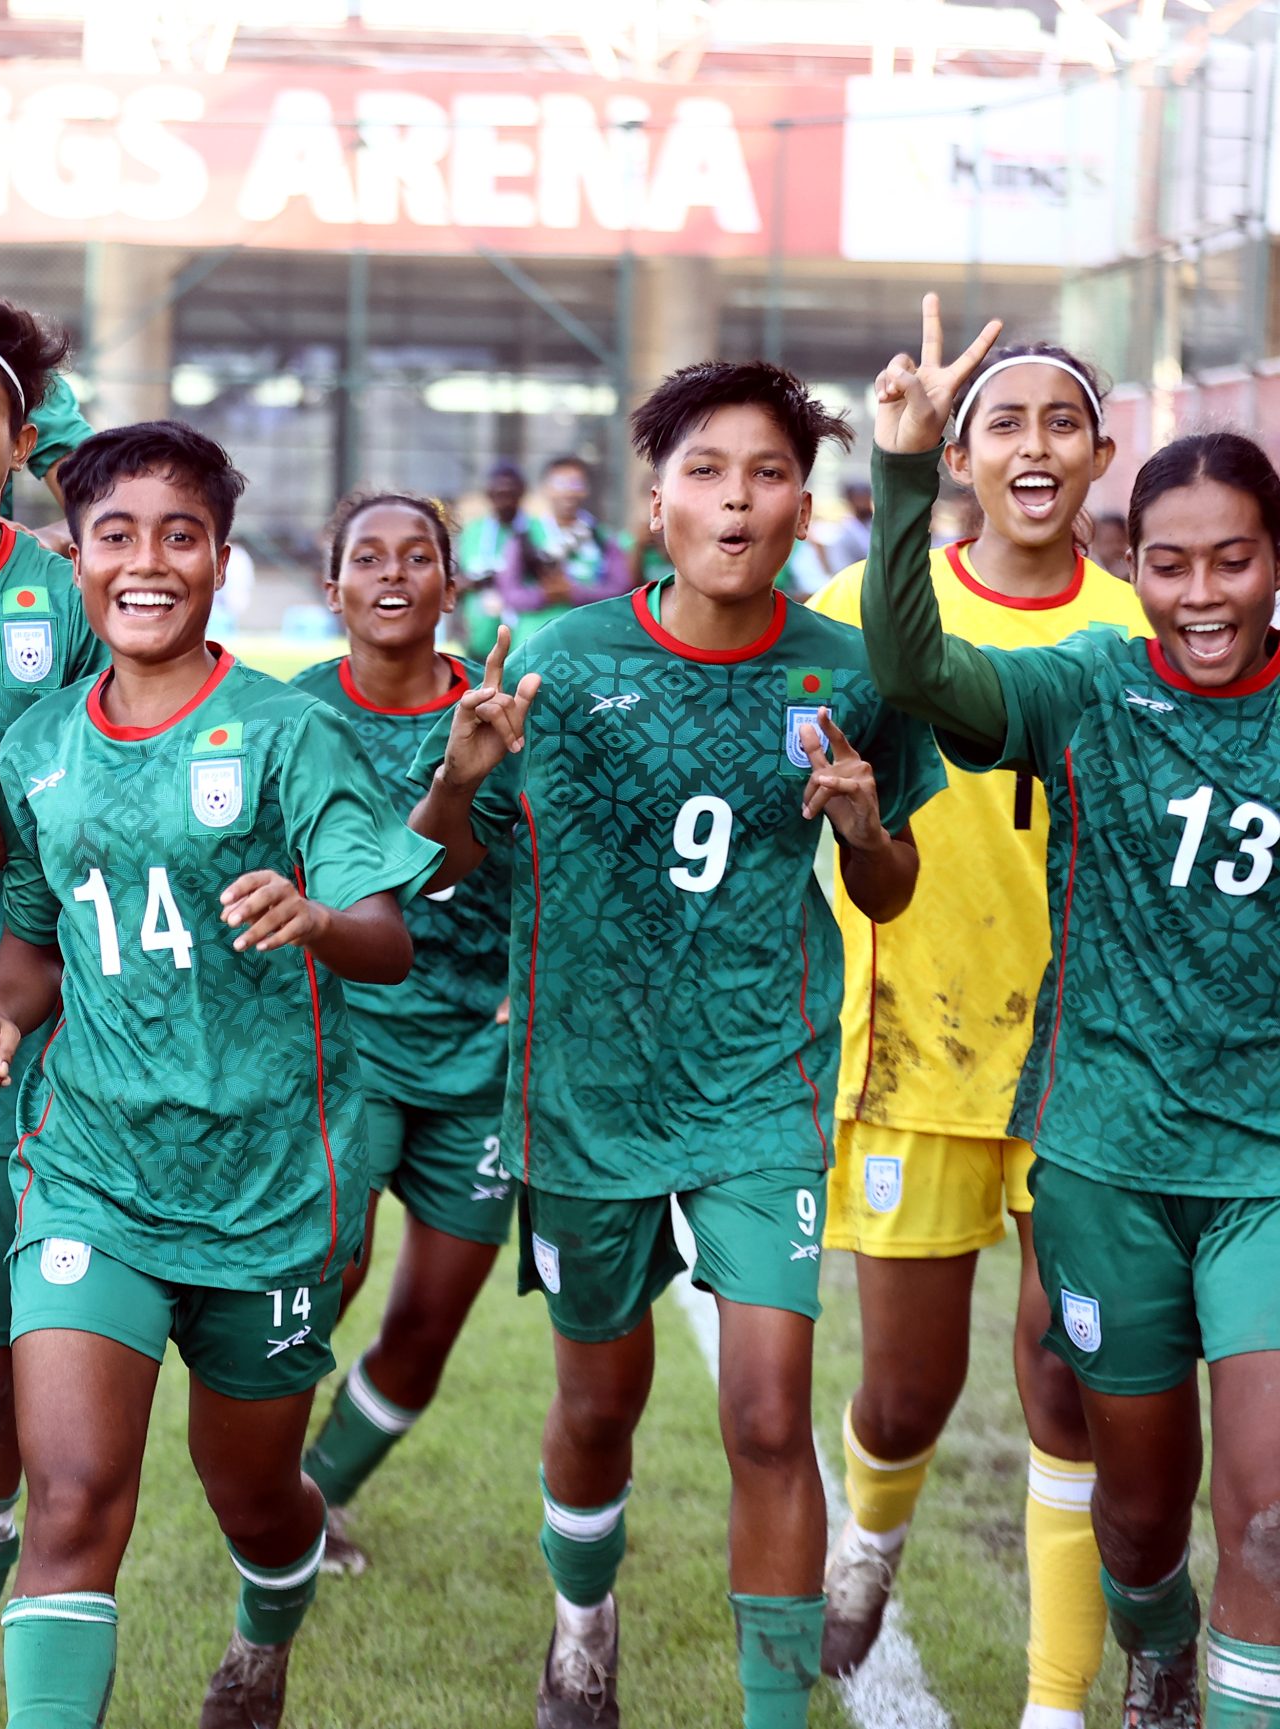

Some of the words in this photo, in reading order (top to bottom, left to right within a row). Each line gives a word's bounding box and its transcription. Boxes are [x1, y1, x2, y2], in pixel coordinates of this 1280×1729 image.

[235, 88, 763, 233] ARENA
[669, 795, 733, 893] 9
[1166, 785, 1280, 896] 13
[72, 867, 194, 976] 14
[796, 1189, 817, 1236] 9
[266, 1287, 311, 1327] 14
